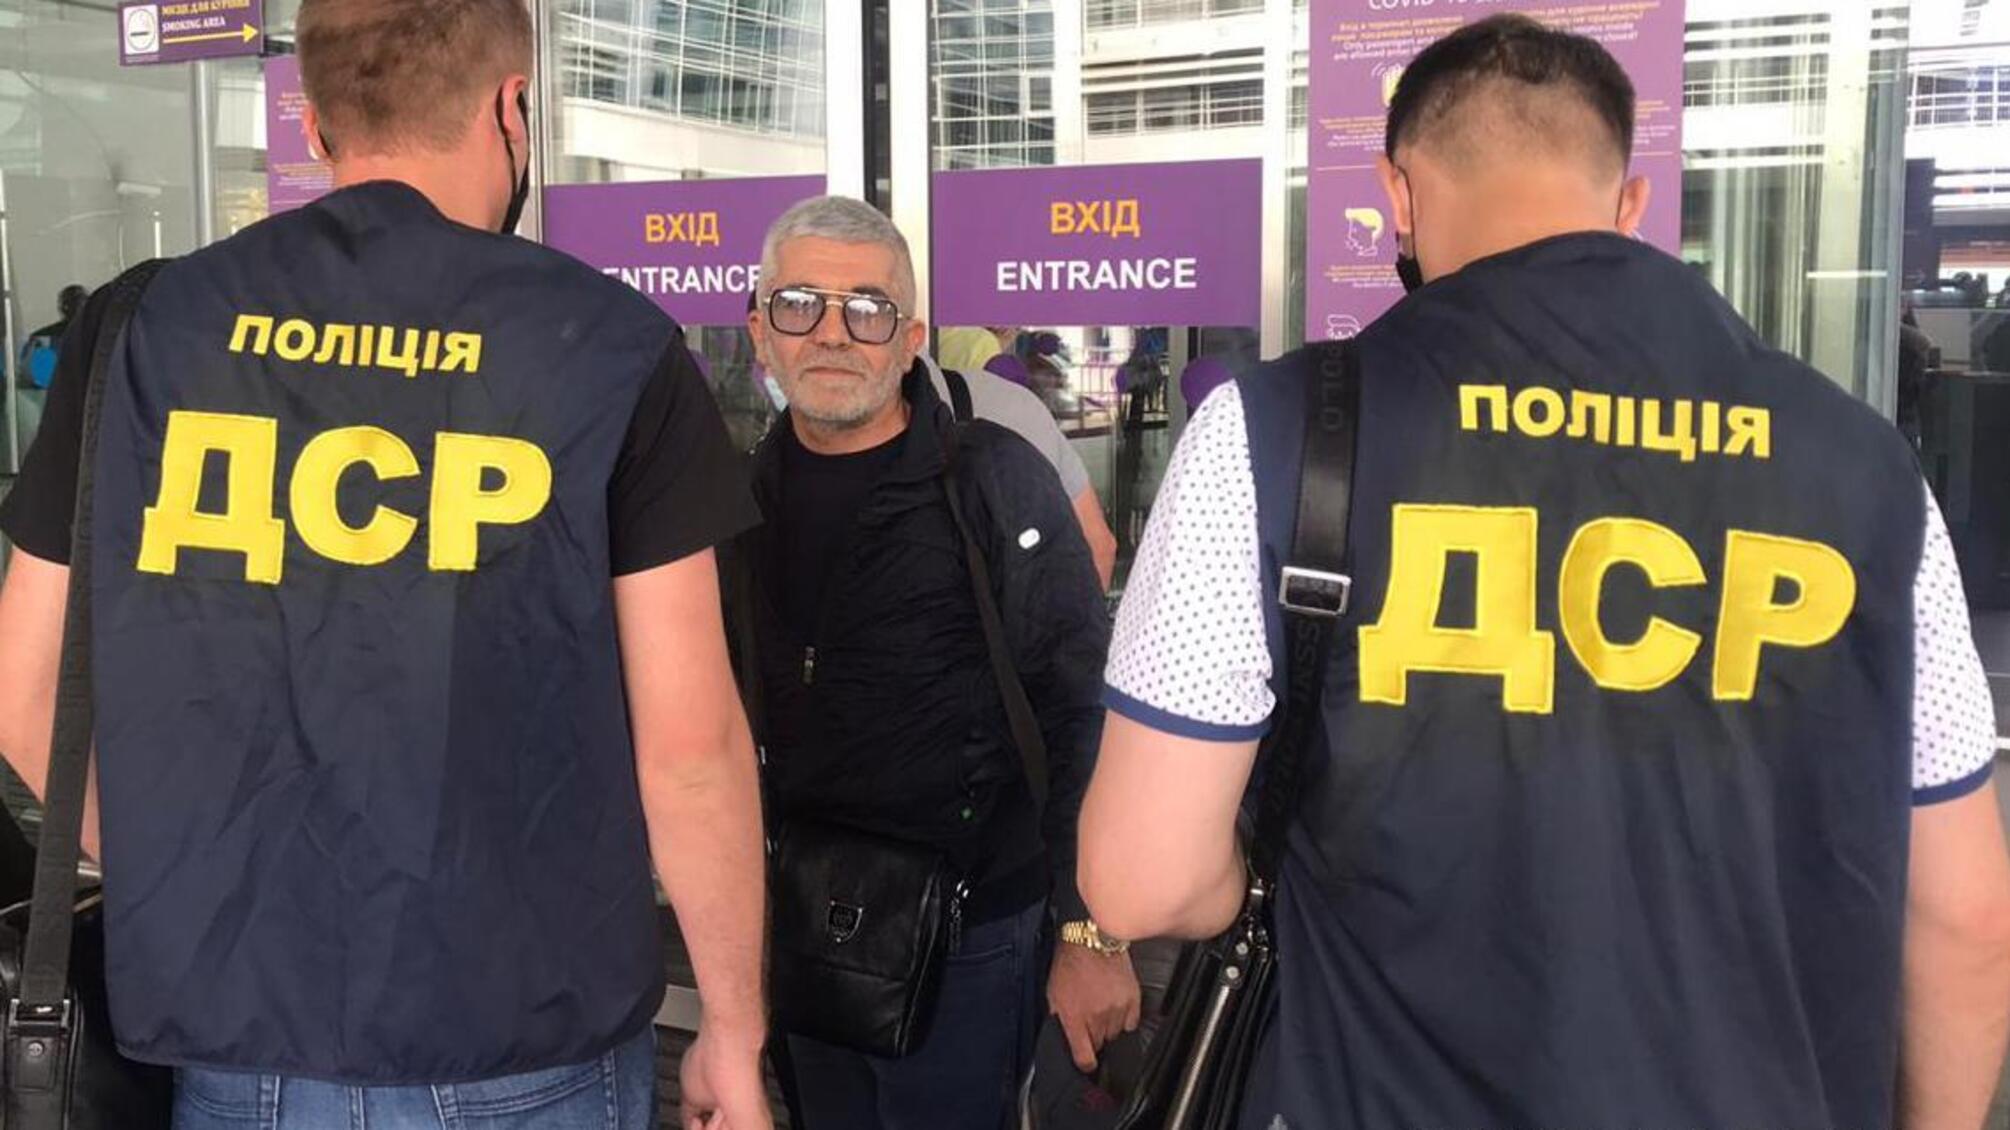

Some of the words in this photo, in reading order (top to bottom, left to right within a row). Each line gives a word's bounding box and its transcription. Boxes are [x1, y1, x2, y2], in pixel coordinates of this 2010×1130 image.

[162, 18, 201, 33] SMOKING
[203, 15, 227, 29] AREA
[645, 211, 720, 247] ВХІД
[1050, 199, 1140, 238] ВХІД
[602, 264, 762, 294] NTRANCE
[996, 257, 1197, 292] ENTRANCE
[228, 313, 482, 377] ПОЛІЦІЯ
[1459, 384, 1772, 462] ПОЛІЦІЯ
[136, 410, 551, 584] ДСР
[1358, 504, 1856, 714] ДСР
